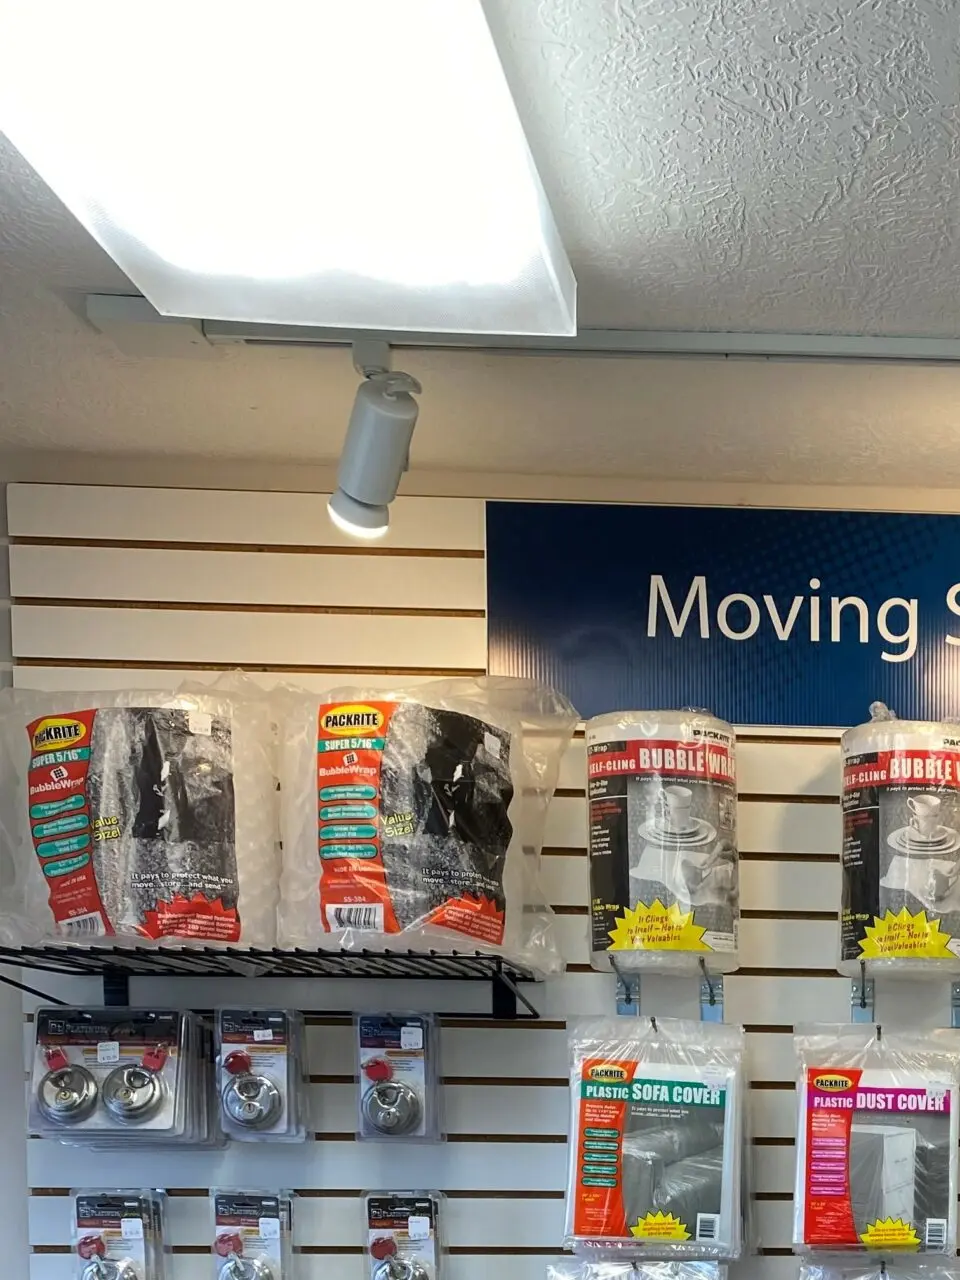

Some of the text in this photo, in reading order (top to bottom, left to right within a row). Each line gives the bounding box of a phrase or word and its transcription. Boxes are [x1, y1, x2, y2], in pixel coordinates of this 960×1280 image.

[647, 574, 918, 663] Moving
[325, 712, 378, 728] PACKRITE
[325, 741, 351, 751] SUPER
[32, 753, 55, 768] SUPER
[639, 748, 704, 775] BUBBLE
[319, 764, 377, 780] BubbleWrap
[890, 757, 953, 781] BUBBLE
[381, 813, 412, 826] Value
[94, 827, 121, 841] Size!
[385, 823, 414, 837] Size!
[590, 1069, 625, 1079] PACKRITE
[816, 1079, 849, 1088] PACKRITE
[586, 1083, 720, 1105] PLASTIC SOFA COVER
[814, 1092, 945, 1112] PLASTIC DUST COVER
